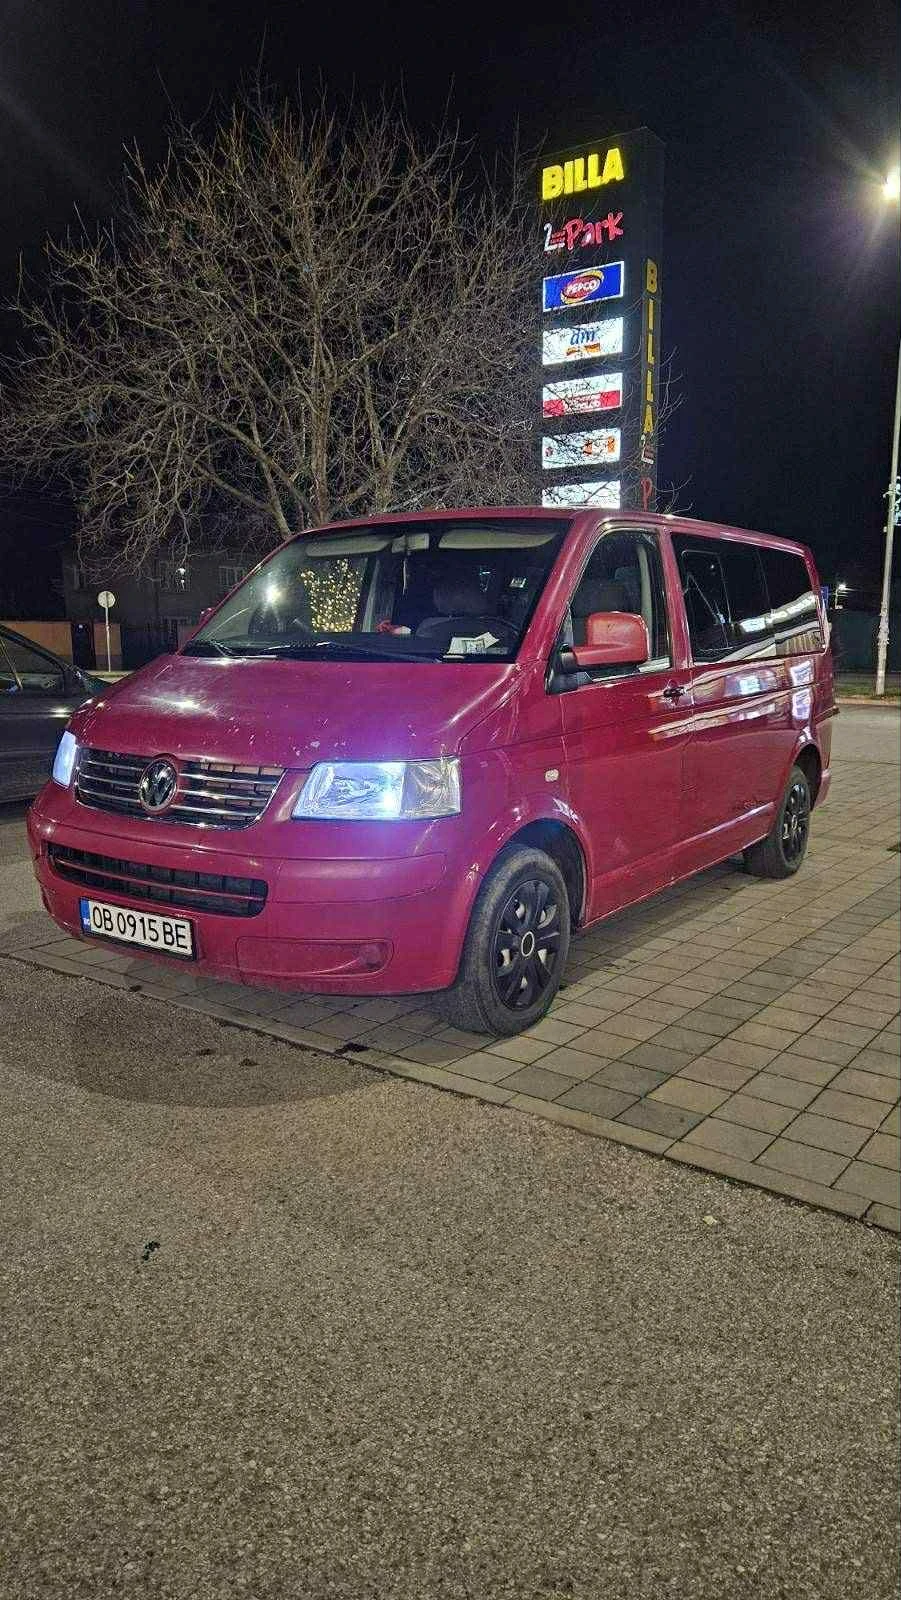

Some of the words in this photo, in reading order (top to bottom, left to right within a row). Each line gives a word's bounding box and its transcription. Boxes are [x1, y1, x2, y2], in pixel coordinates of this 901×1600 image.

[542, 148, 625, 200] BILLA
[565, 212, 624, 250] Park
[566, 279, 598, 294] PEPCO
[570, 327, 597, 345] dm
[645, 258, 658, 433] BILLA
[92, 905, 114, 932] OB
[116, 912, 160, 942] 0915
[163, 921, 188, 949] BE
